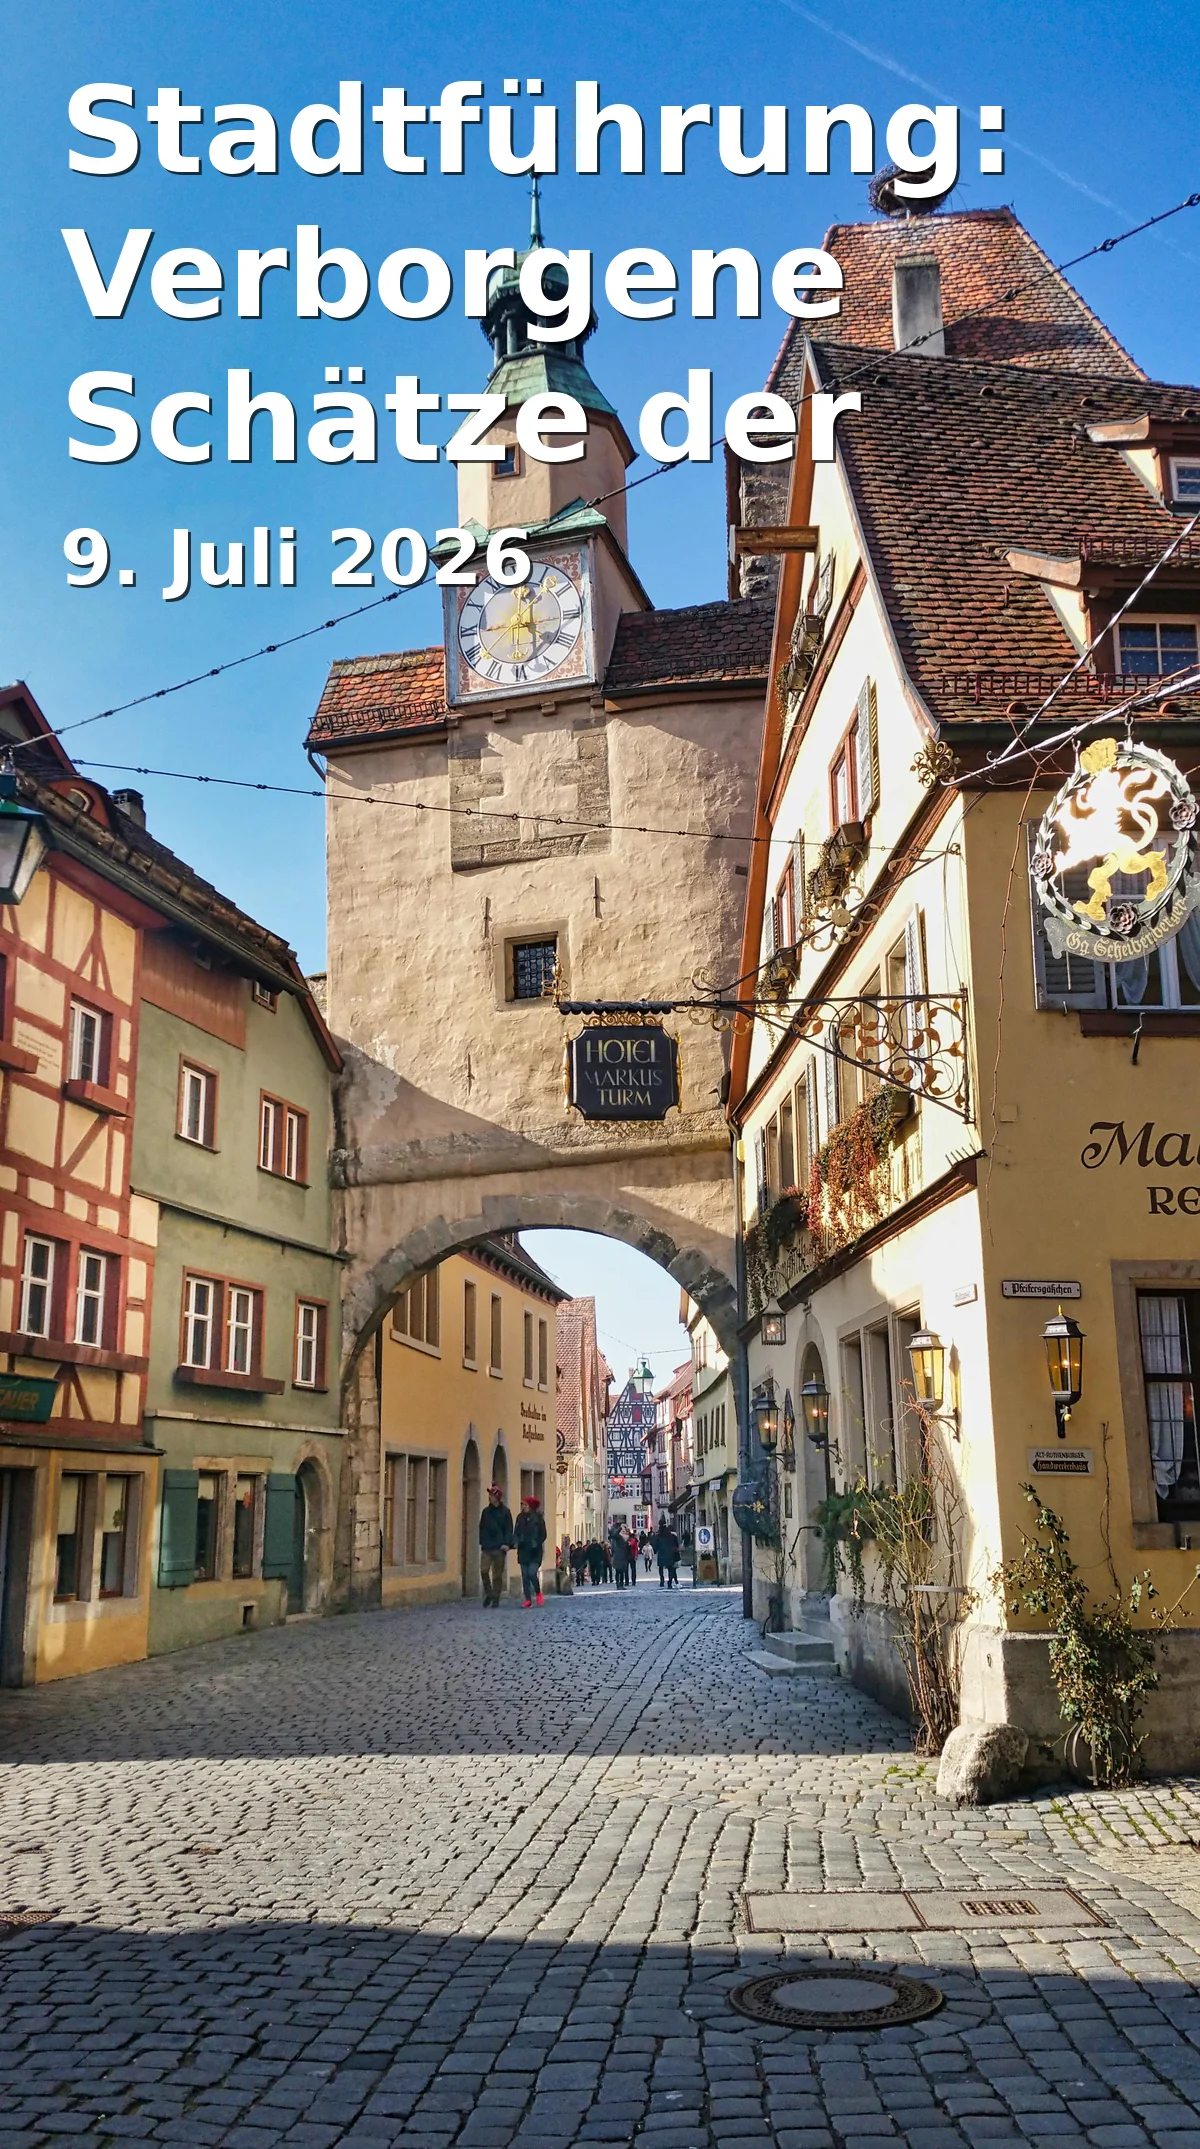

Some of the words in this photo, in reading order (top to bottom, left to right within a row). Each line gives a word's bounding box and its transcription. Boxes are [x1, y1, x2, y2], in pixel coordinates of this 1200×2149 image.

[1066, 932, 1090, 955] Gg.
[586, 1039, 660, 1063] HOTEL
[584, 1069, 662, 1086] MARKUS
[597, 1089, 651, 1106] TURM
[1081, 1120, 1200, 1169] Ma
[1011, 1283, 1072, 1295] Pfeifersgäßchen
